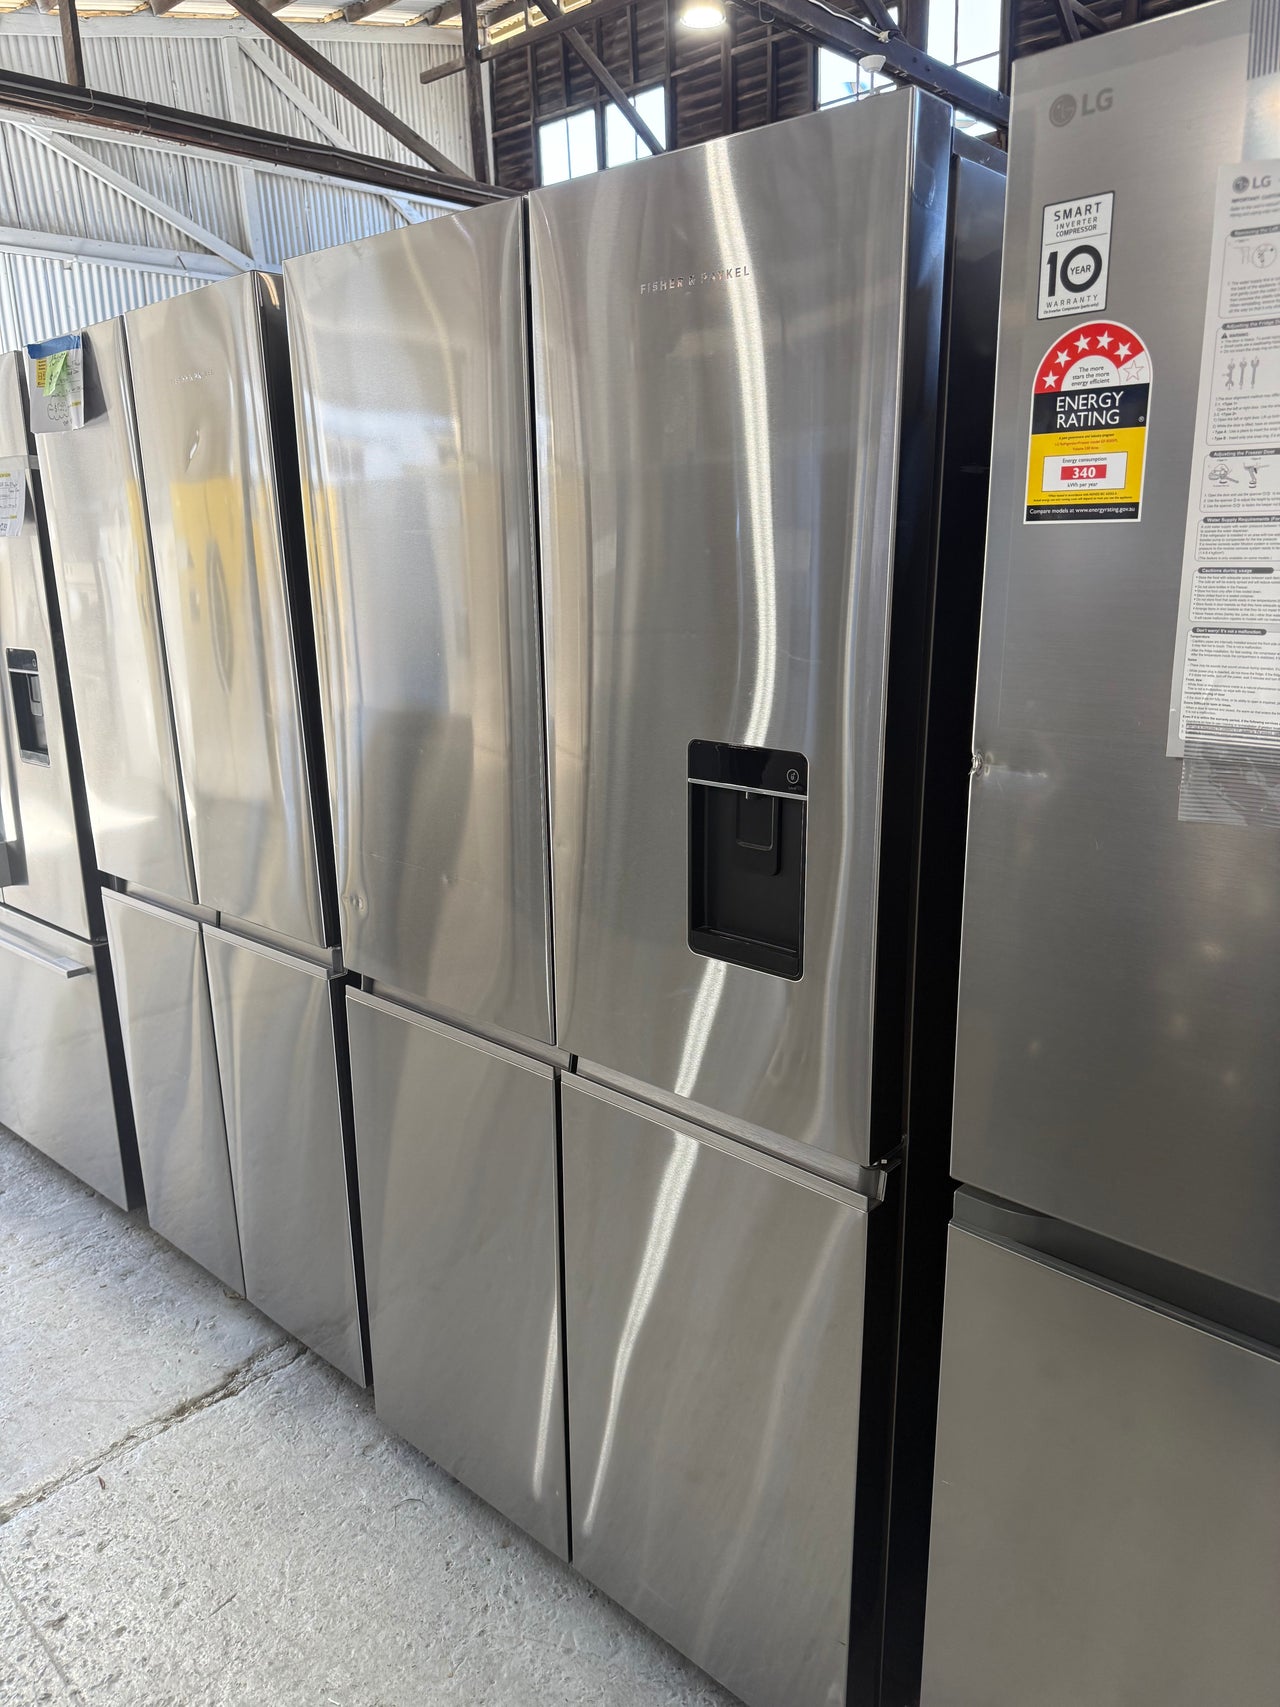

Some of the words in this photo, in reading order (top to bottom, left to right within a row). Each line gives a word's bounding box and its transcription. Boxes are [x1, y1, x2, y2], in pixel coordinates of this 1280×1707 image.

[1081, 88, 1113, 116] LG
[1253, 175, 1272, 189] LG
[1054, 202, 1102, 222] SMART
[1056, 216, 1097, 230] INVERTER
[1056, 224, 1097, 237] COMPRESSOR
[1047, 245, 1102, 297] 10
[1070, 265, 1091, 275] YEAR
[640, 278, 683, 295] FISHER
[701, 266, 749, 284] PAYKEL
[1046, 295, 1098, 308] WARRANTY
[1056, 391, 1124, 412] ENERGY
[1056, 409, 1120, 428] RATING
[1072, 467, 1096, 478] 340
[1076, 506, 1135, 514] www.energyrating.gov.au
